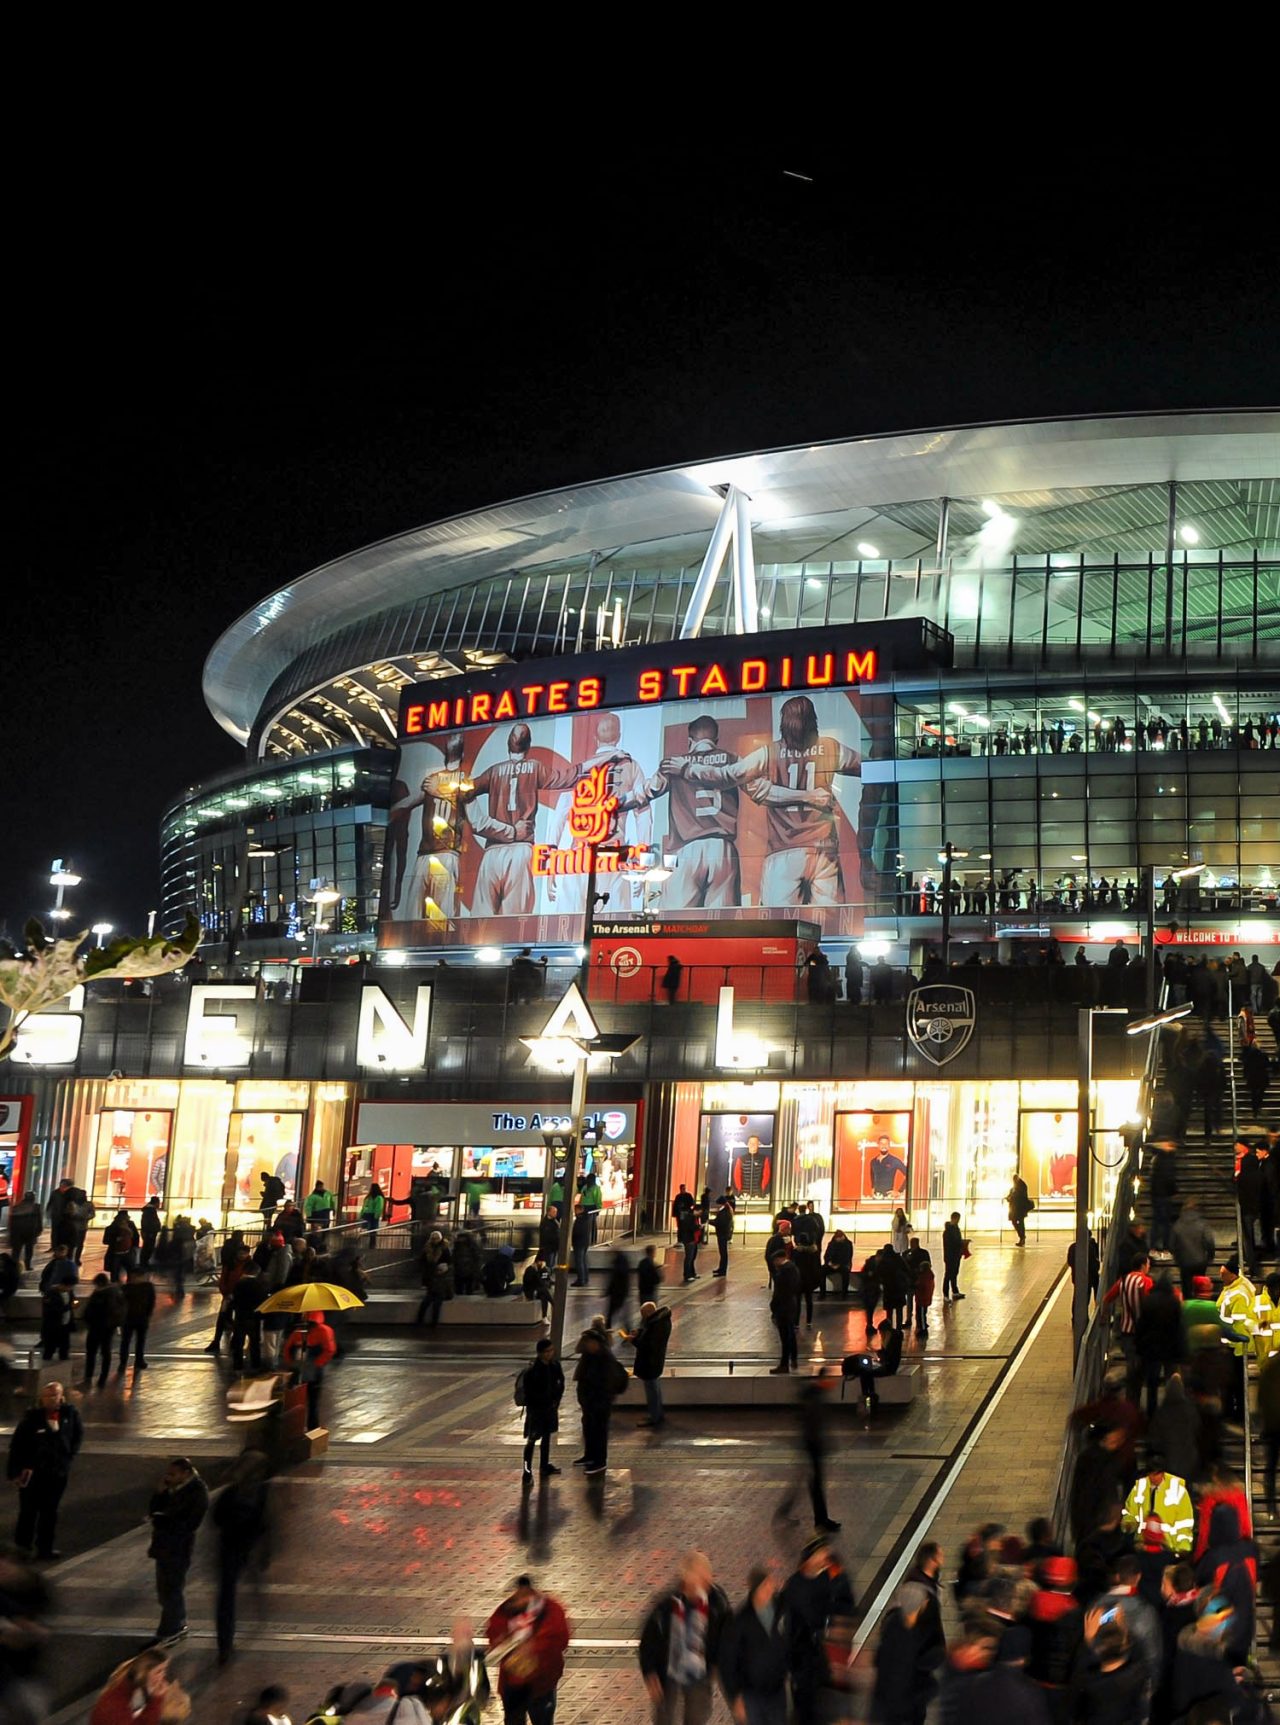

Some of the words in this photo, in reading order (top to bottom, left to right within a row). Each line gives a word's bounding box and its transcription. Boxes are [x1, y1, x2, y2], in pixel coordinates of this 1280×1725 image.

[405, 677, 602, 734] EMIRATES
[638, 650, 877, 701] STADIUM
[498, 762, 535, 777] WILSON
[592, 924, 610, 934] The
[612, 924, 650, 934] Arsenal
[1176, 931, 1217, 943] WELCOME
[1219, 931, 1231, 943] TO
[915, 1000, 967, 1013] Arsenal
[492, 1112, 527, 1131] The
[529, 1112, 600, 1131] Arseal
